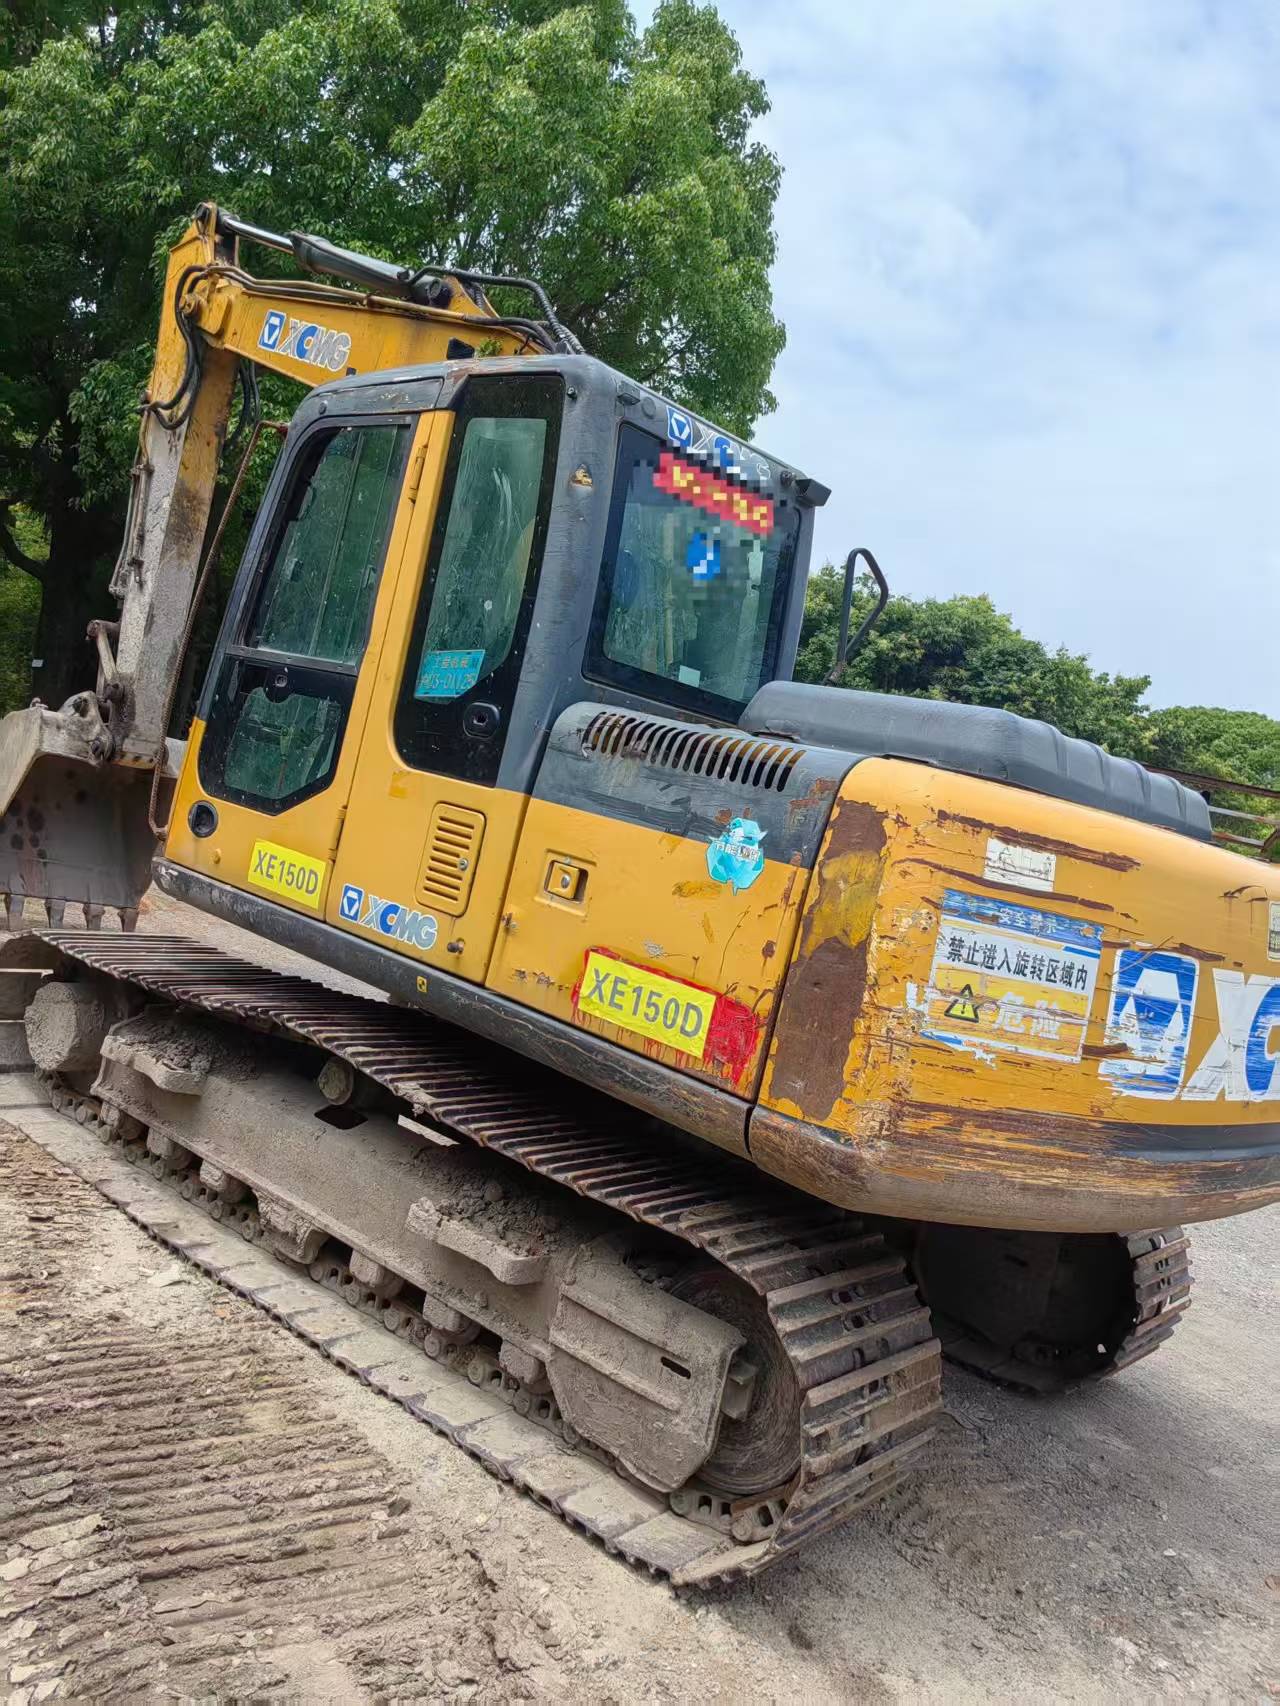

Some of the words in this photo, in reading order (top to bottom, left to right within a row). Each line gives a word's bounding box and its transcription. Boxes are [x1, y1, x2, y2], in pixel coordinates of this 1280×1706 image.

[277, 317, 352, 372] XCMG
[253, 849, 319, 895] XE150D
[360, 894, 438, 950] XCMG
[946, 935, 1088, 991] 禁止进入旋转区域内
[588, 967, 702, 1038] XE150D
[994, 991, 1061, 1041] 危险
